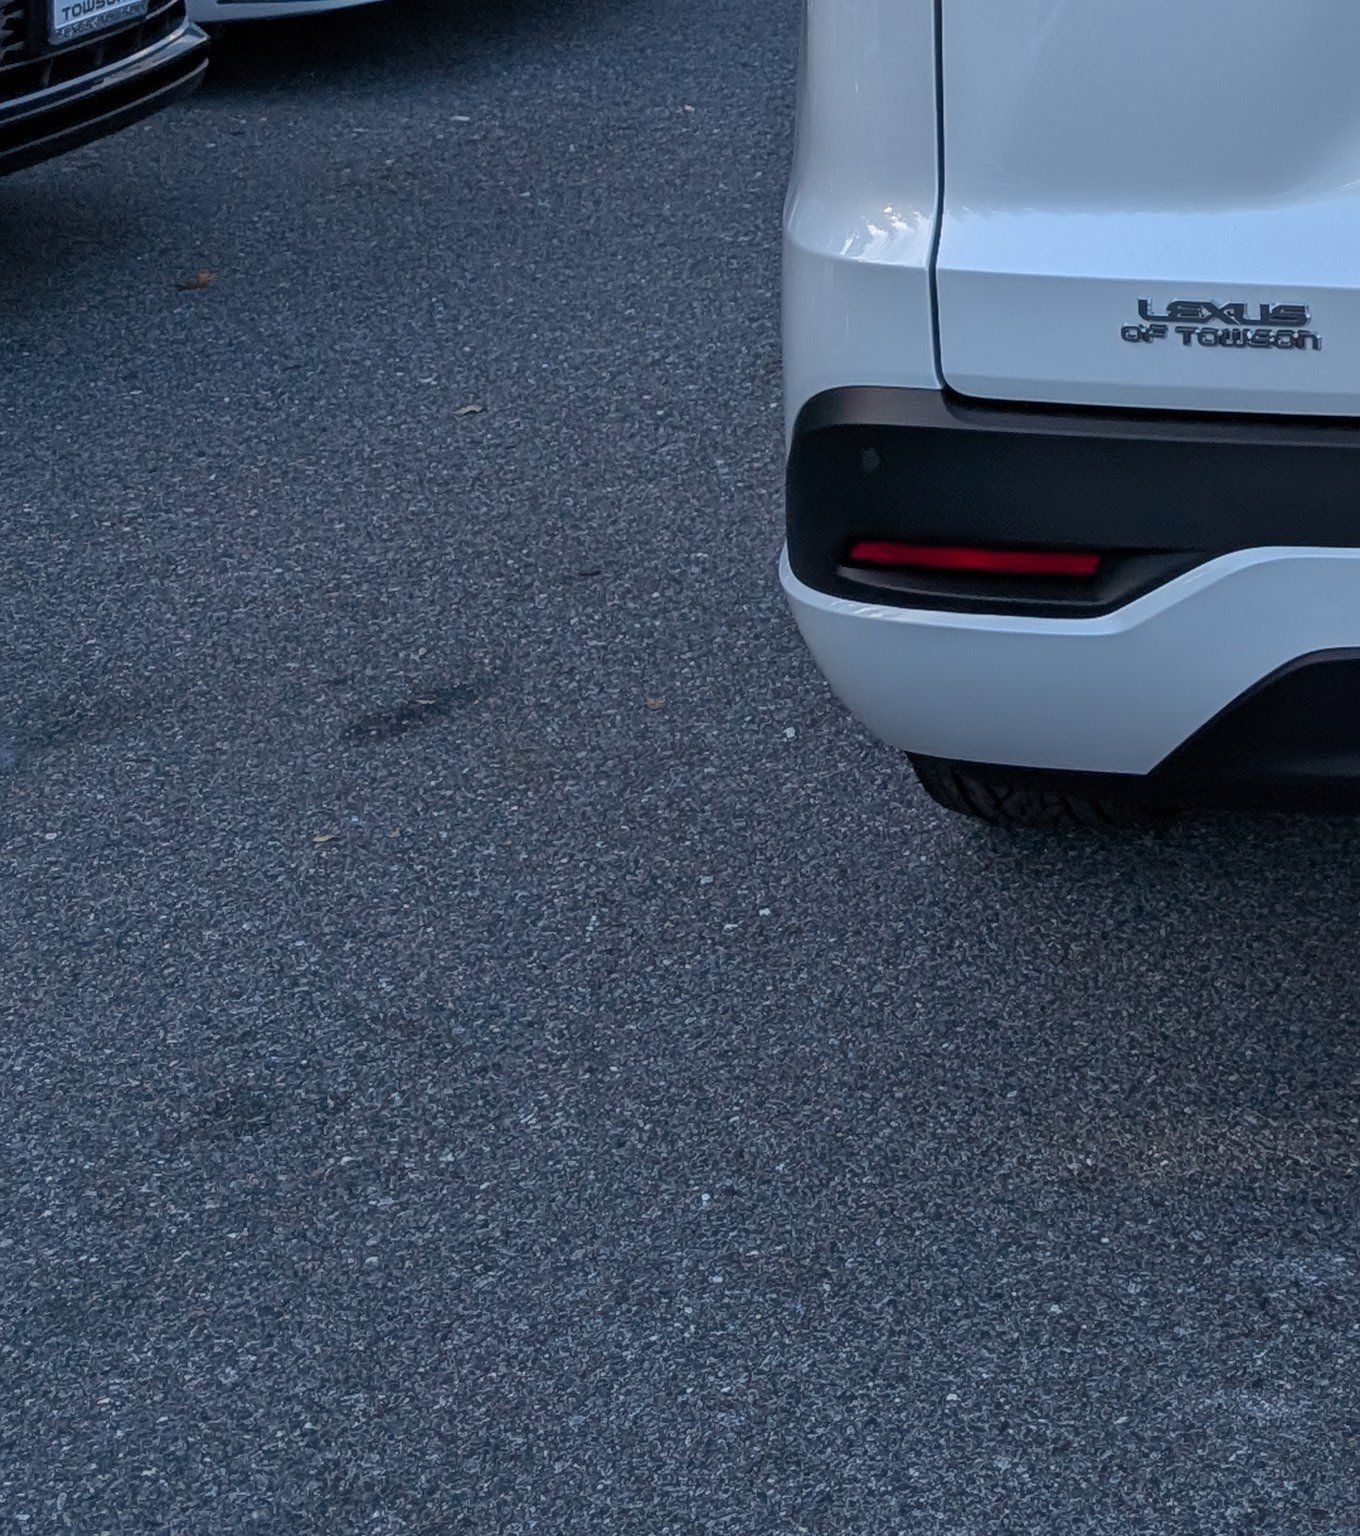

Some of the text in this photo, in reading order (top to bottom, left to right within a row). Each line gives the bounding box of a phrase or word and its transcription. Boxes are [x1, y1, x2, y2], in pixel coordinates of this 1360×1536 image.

[1137, 296, 1313, 327] LEXUS
[1120, 322, 1322, 351] OF TOWSON
